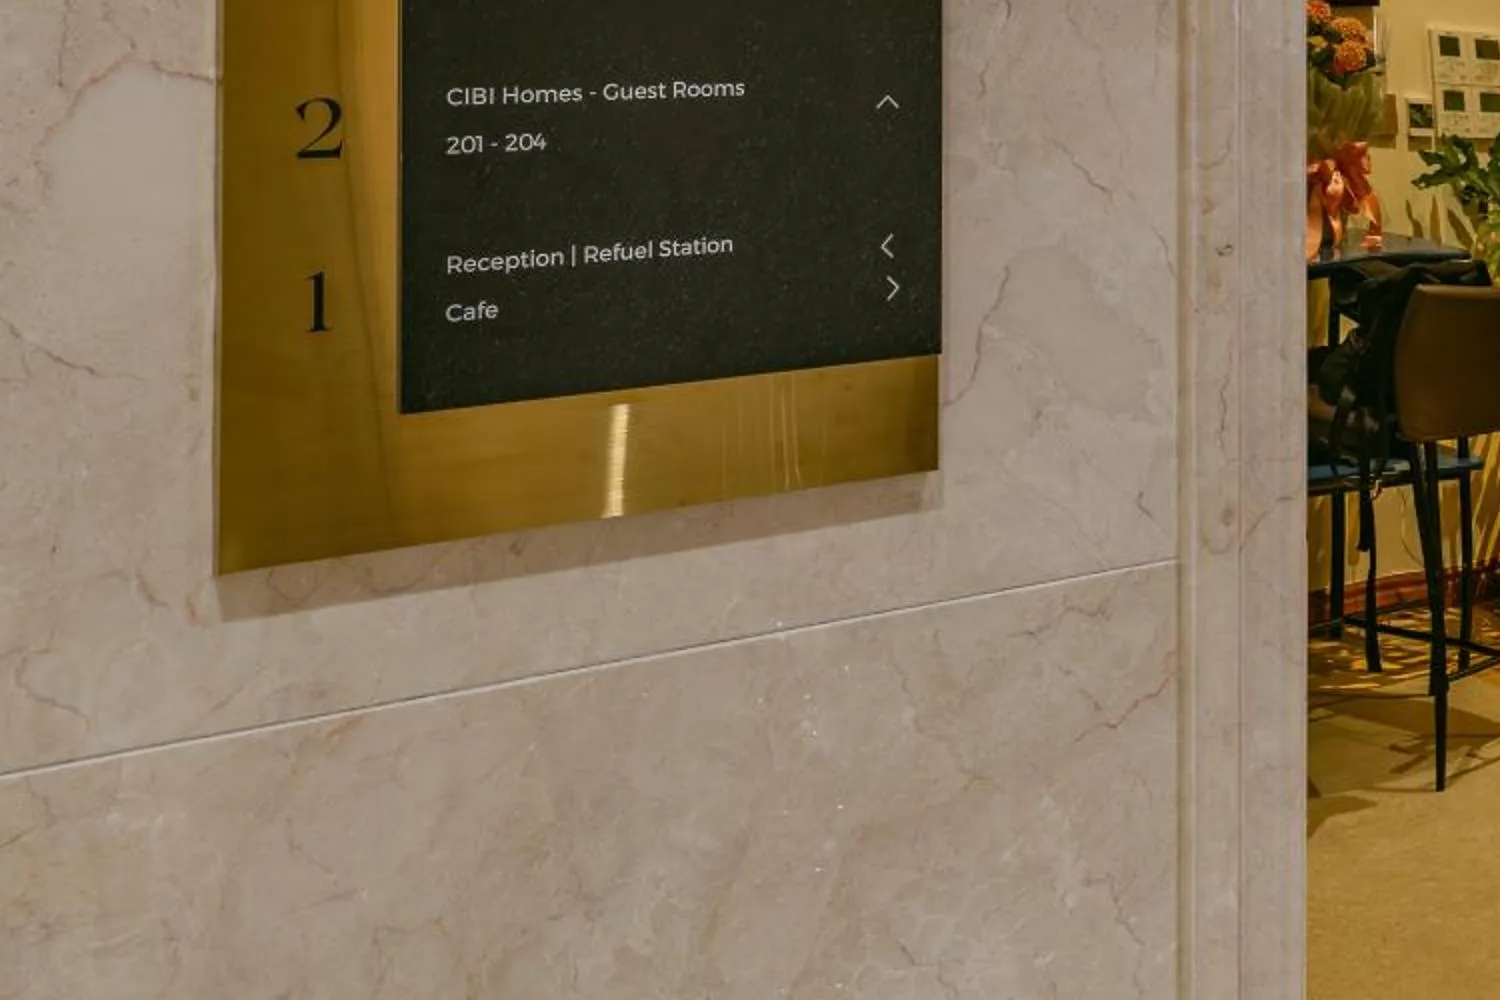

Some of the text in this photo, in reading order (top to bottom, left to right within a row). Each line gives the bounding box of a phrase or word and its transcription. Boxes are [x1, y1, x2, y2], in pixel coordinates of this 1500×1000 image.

[446, 87, 495, 107] CIBI
[502, 85, 584, 105] Homes
[602, 82, 668, 101] Guest
[672, 80, 745, 99] Rooms
[295, 97, 343, 160] 2
[446, 135, 483, 155] 201
[504, 132, 547, 153] 204
[447, 249, 565, 275] Reception
[583, 239, 653, 264] Refuel
[658, 235, 734, 258] Station
[303, 271, 331, 333] 1
[445, 300, 499, 323] Cafe
